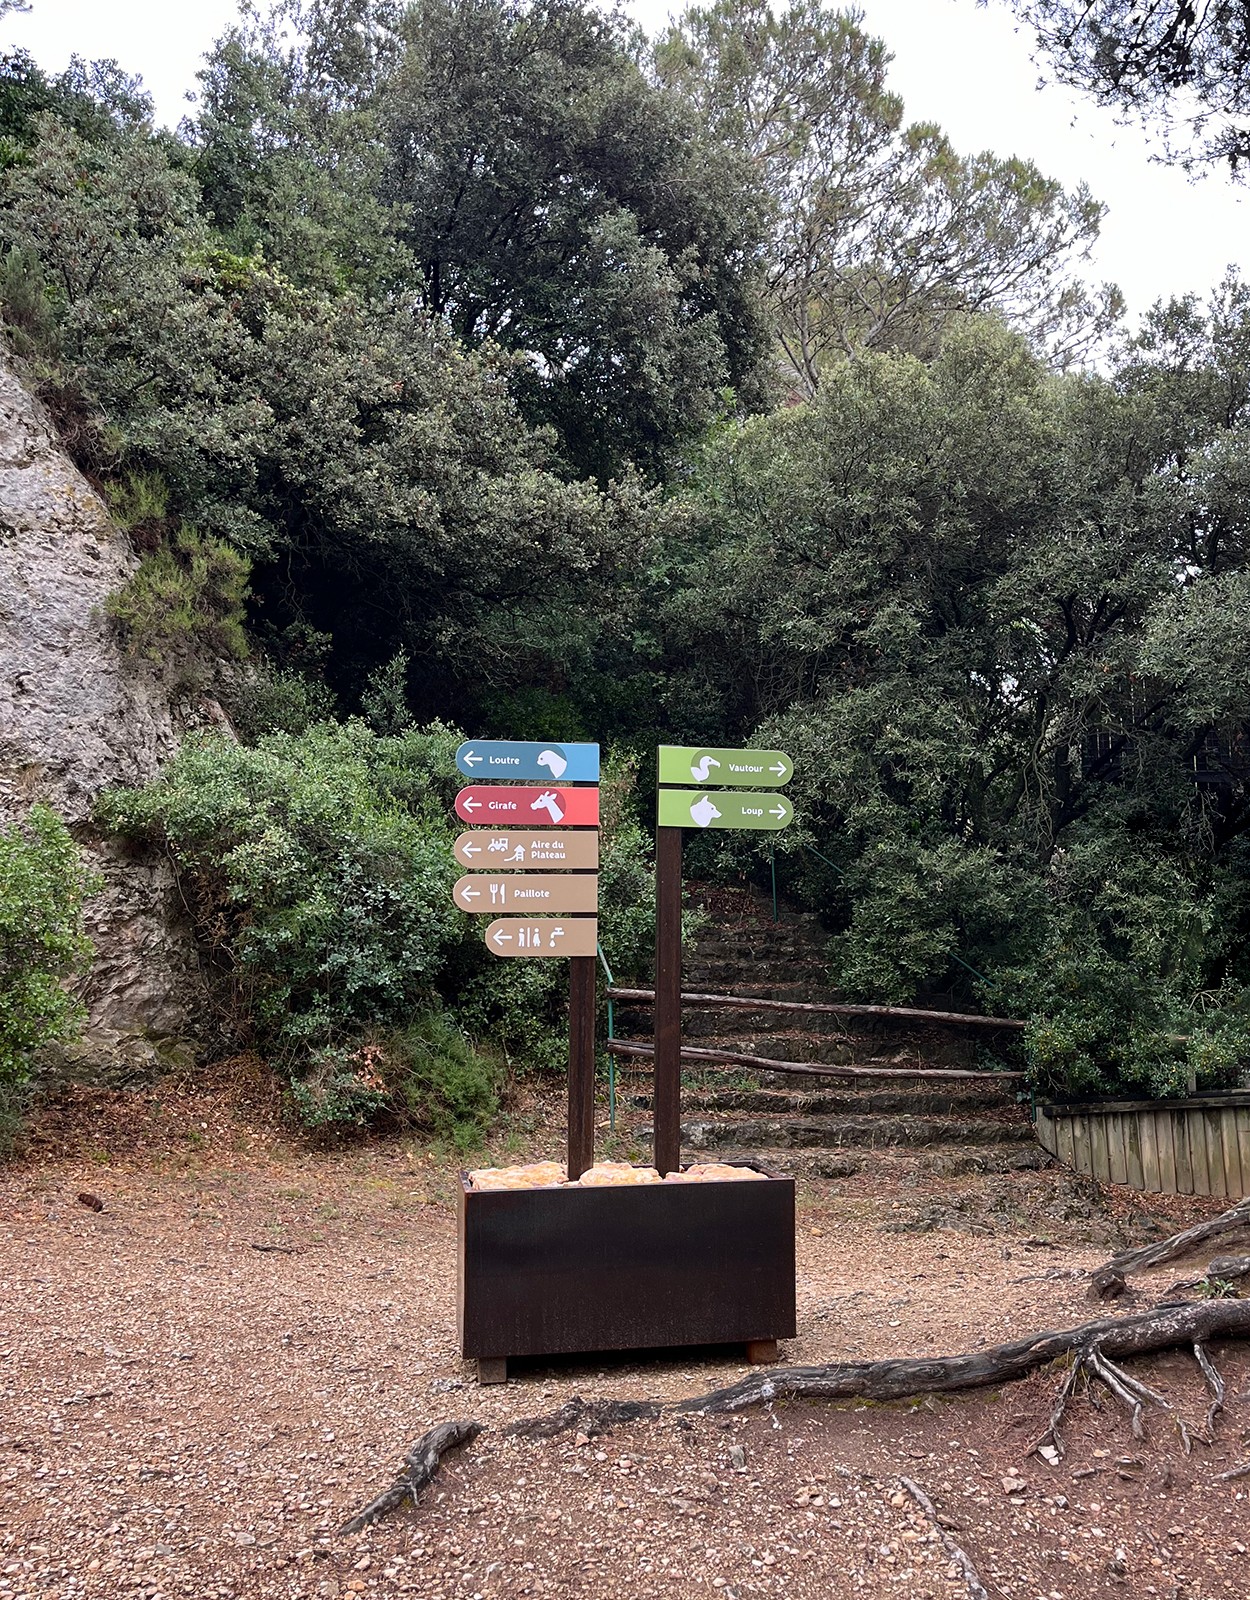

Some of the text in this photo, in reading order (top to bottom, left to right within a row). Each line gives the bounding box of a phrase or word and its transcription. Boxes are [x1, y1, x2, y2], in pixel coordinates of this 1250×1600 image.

[489, 756, 520, 765] Loutre
[729, 764, 764, 772] Vautour
[488, 802, 517, 810] Girafe
[741, 807, 763, 817] Loup
[531, 840, 564, 849] Aire du
[531, 851, 566, 859] Plateau
[514, 889, 550, 898] Paillote
